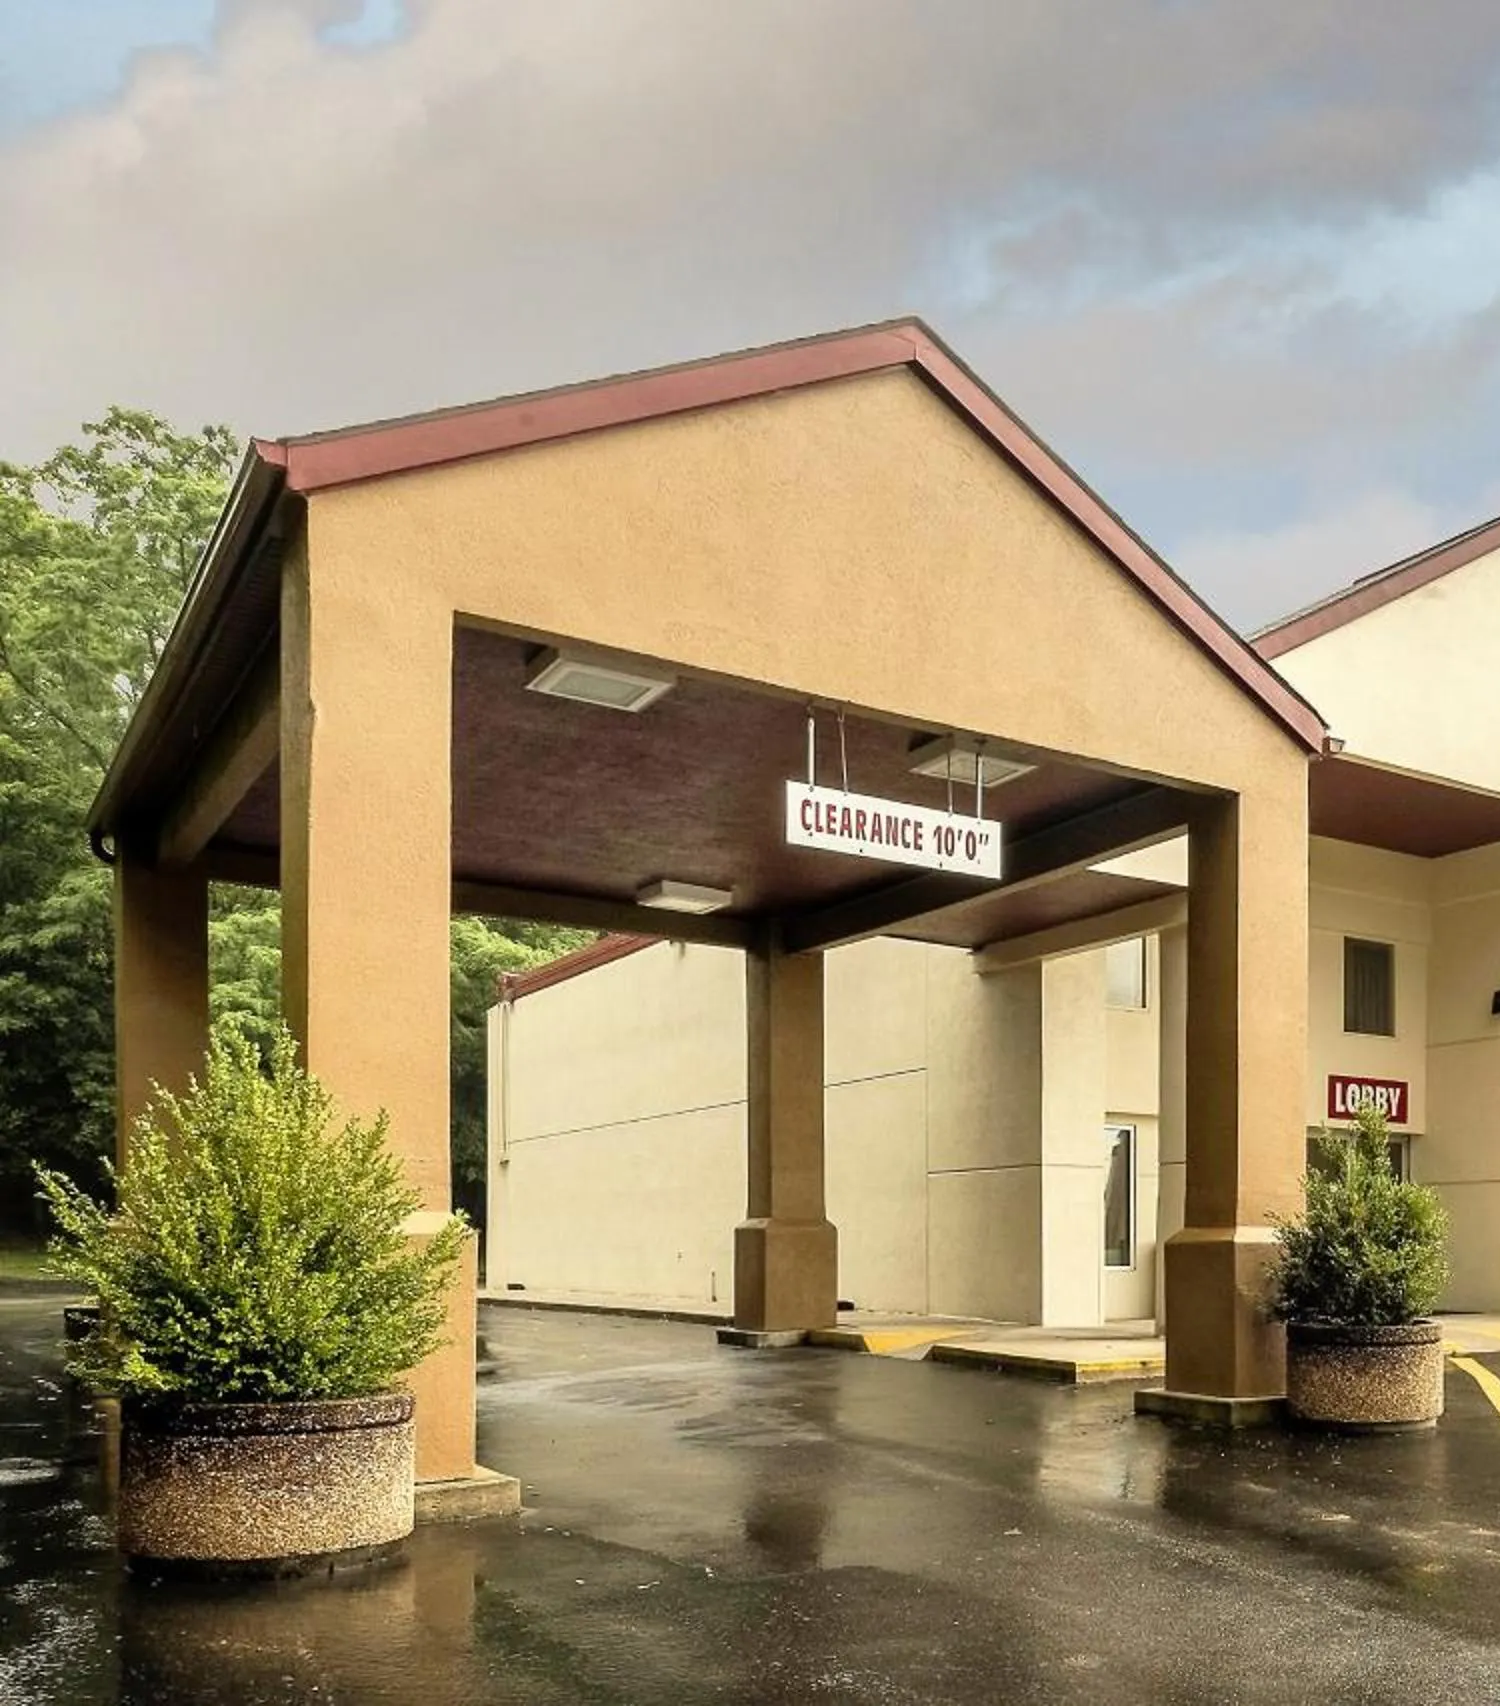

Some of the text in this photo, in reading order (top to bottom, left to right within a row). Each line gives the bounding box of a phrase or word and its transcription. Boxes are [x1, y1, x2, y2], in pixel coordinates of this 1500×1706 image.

[800, 799, 990, 861] CLEARANCE 10'0"
[1335, 1082, 1401, 1117] LOBBY
